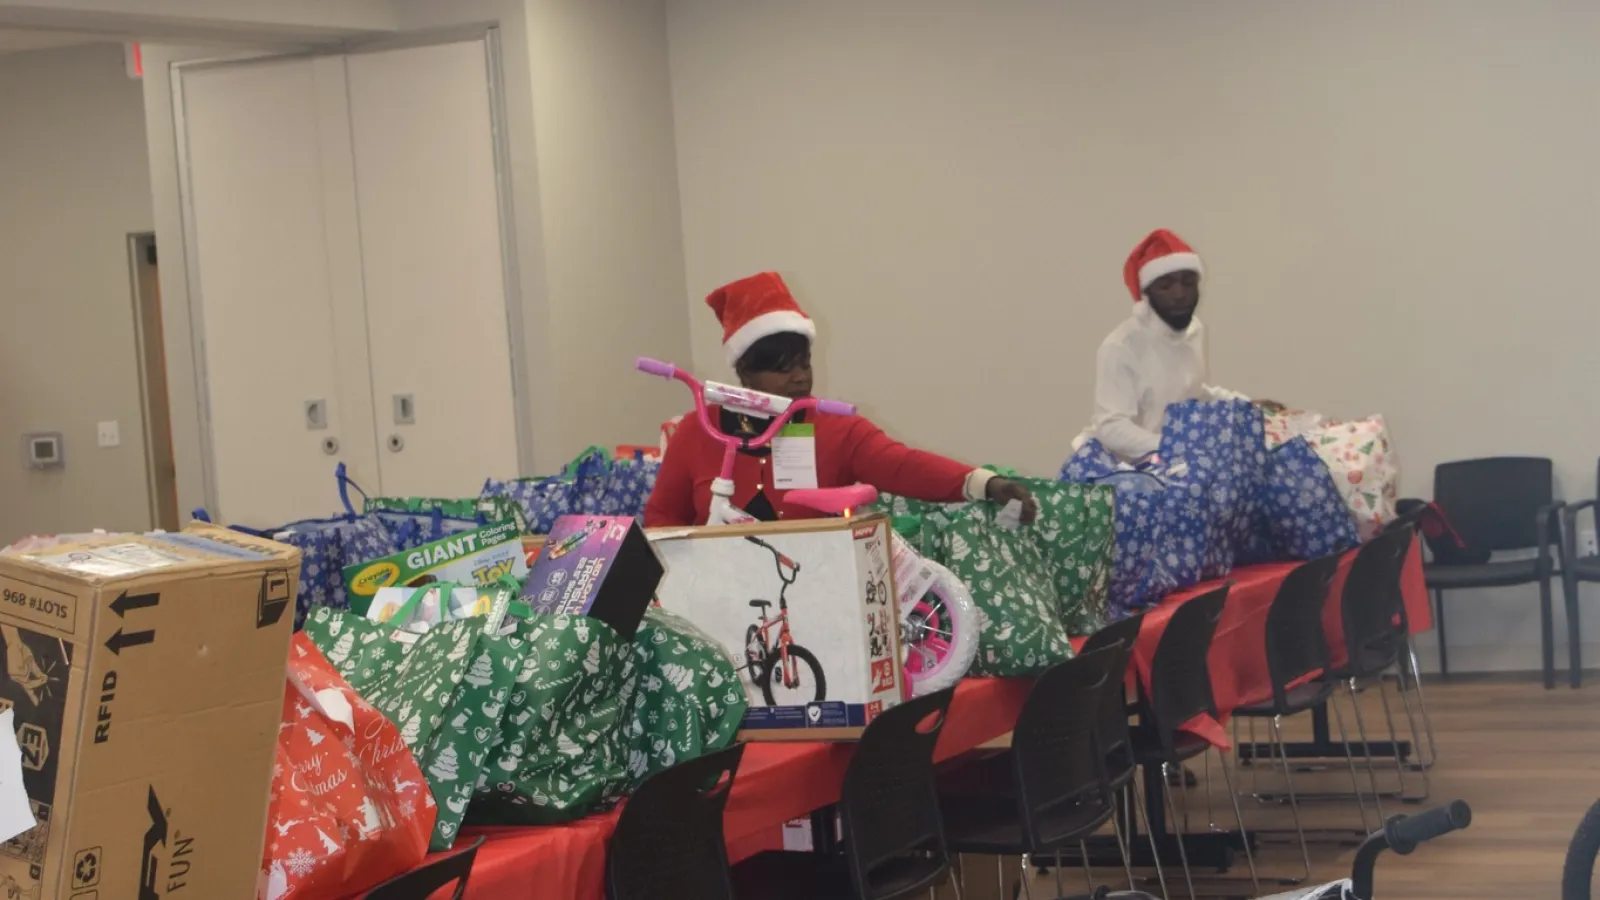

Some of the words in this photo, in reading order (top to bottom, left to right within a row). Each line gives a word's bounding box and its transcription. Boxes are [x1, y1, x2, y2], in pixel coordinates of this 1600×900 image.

[478, 521, 516, 539] Coloring
[481, 532, 507, 546] Pages
[406, 534, 478, 570] GIANT
[2, 588, 27, 606] 896
[29, 597, 68, 620] SLOT#
[93, 669, 118, 744] RFID
[20, 729, 42, 767] EZ
[166, 837, 195, 894] FUN
